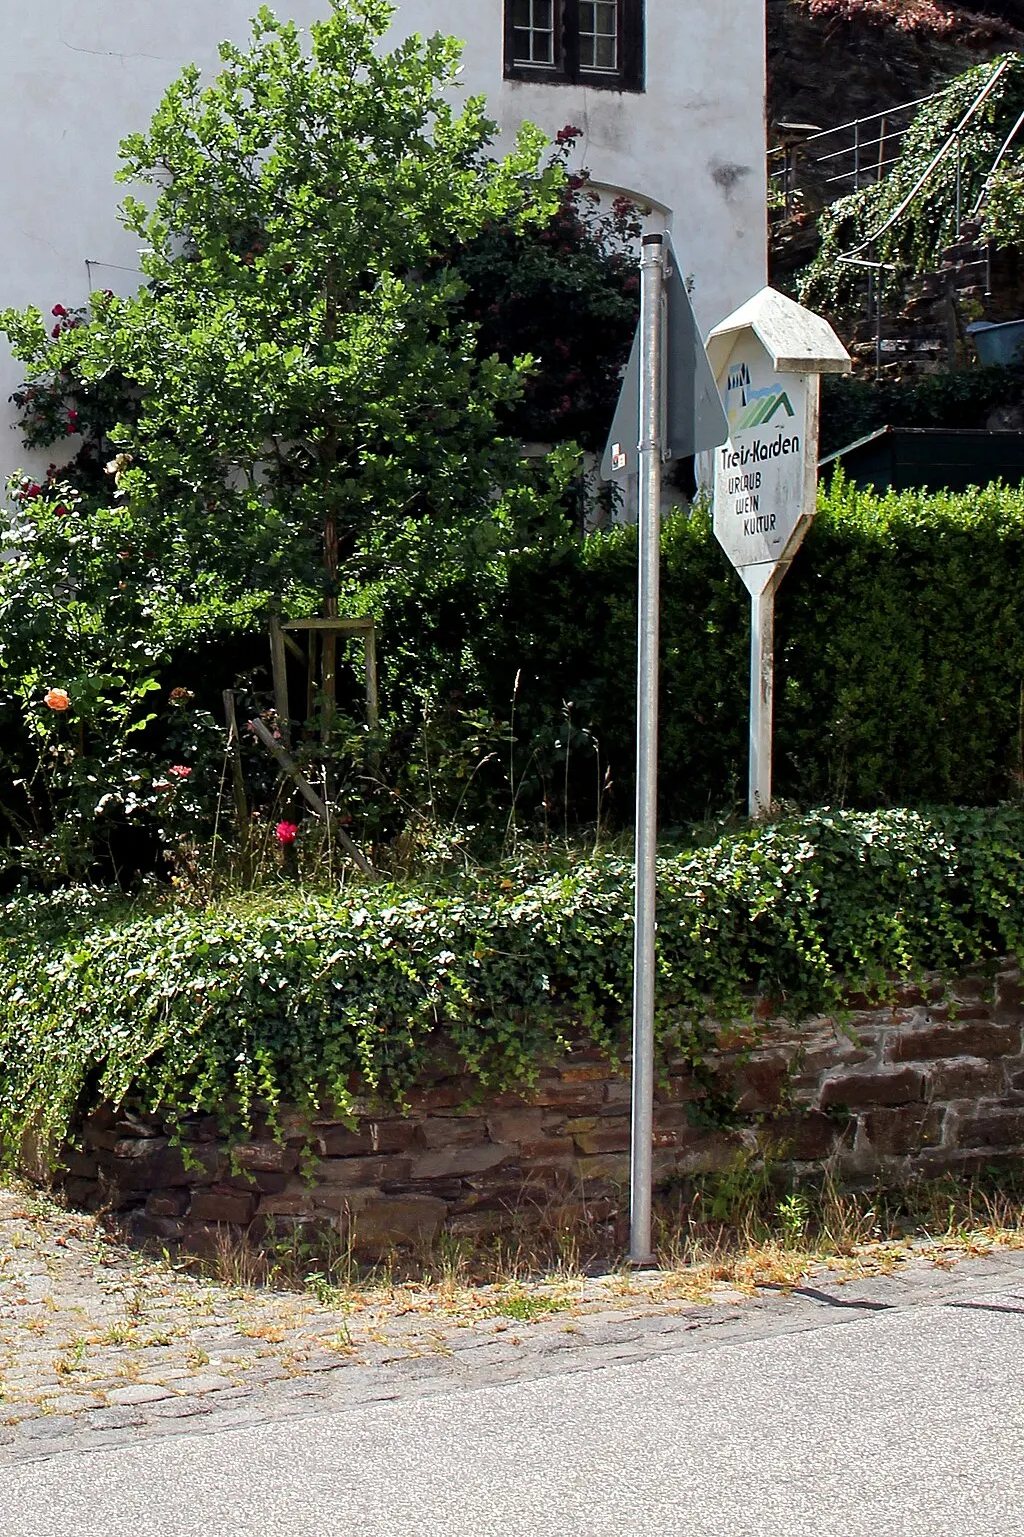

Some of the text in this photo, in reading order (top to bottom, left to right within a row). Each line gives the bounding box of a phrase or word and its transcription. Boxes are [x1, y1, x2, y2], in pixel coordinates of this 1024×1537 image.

[721, 433, 800, 470] Treis-Karden
[728, 471, 762, 495] URLAUB
[735, 495, 760, 515] WEIN
[744, 513, 776, 536] KULTUR
